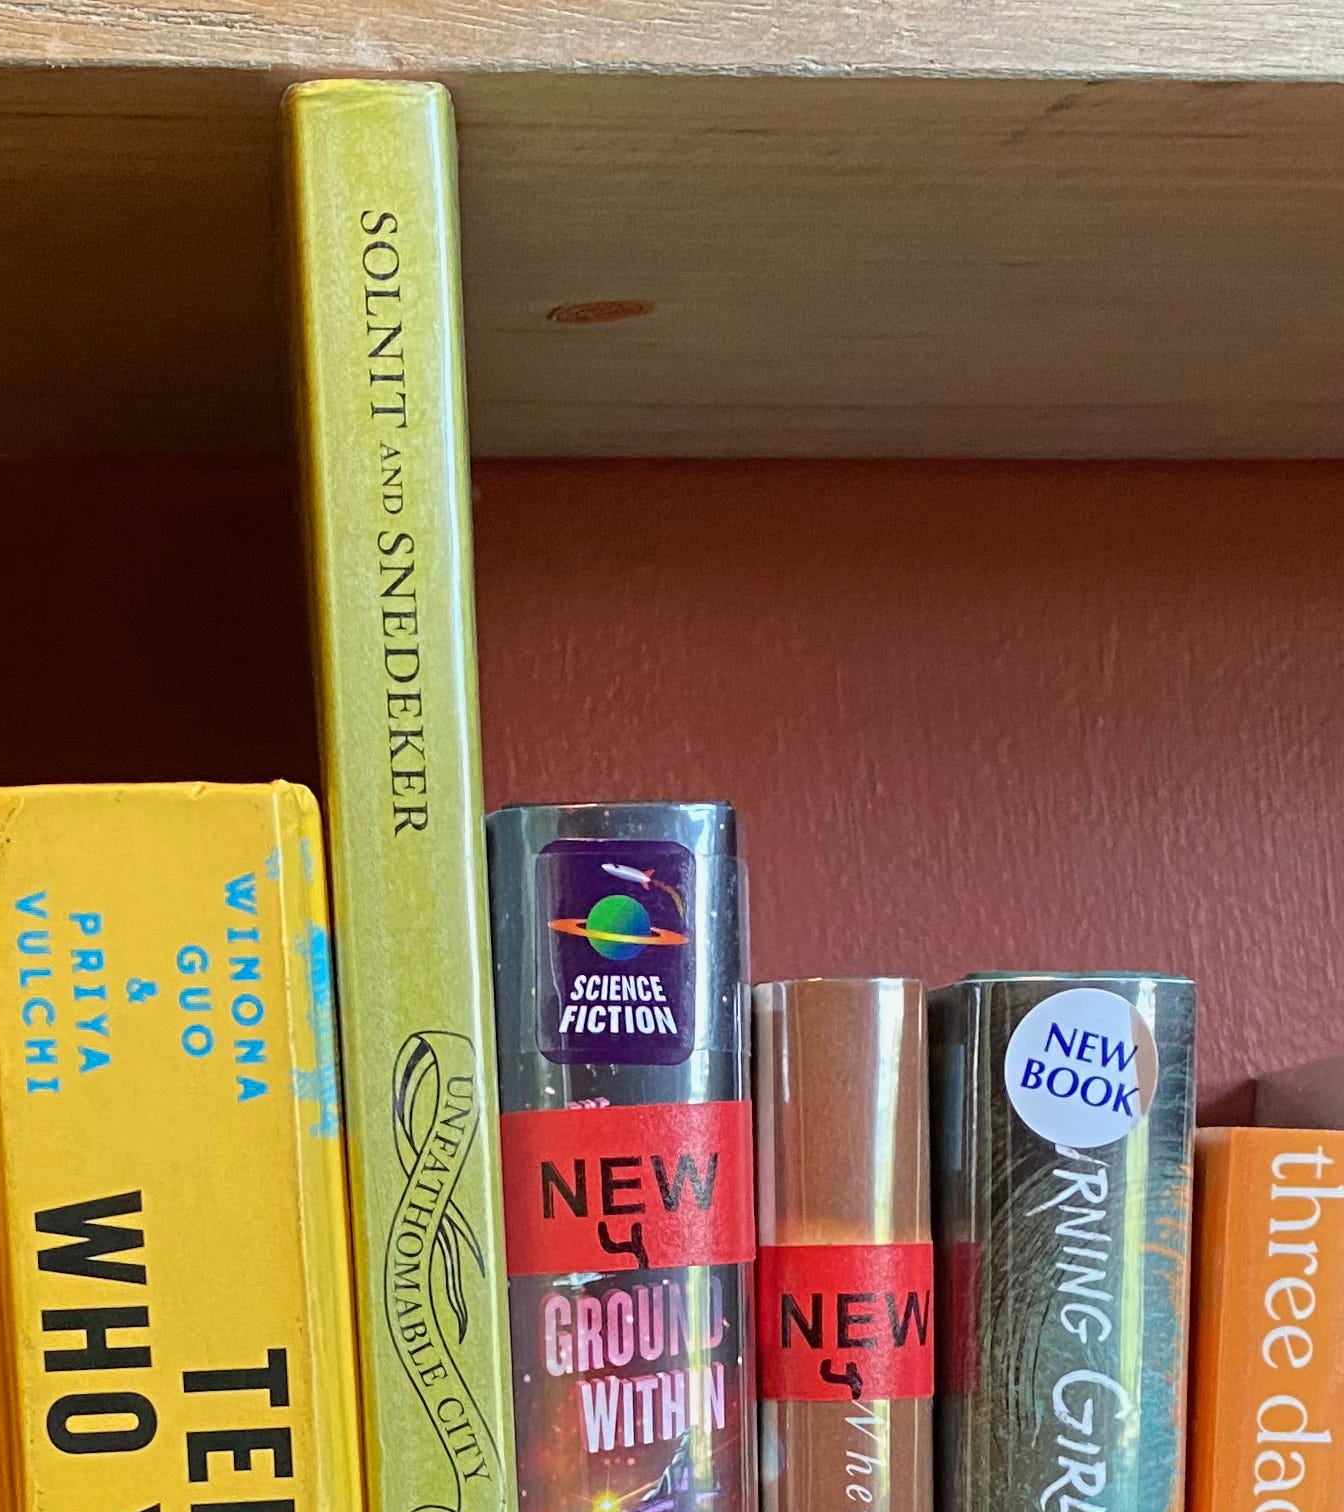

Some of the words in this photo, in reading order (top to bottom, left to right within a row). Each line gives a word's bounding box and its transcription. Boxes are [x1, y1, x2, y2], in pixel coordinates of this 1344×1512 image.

[360, 210, 407, 428] SOLNIT
[380, 442, 404, 515] AND
[377, 531, 429, 837] SNEDEKER
[13, 889, 60, 1096] VULCHI
[68, 911, 111, 1073] PRIYA
[125, 976, 159, 1003] &
[176, 944, 214, 1059] GUO
[223, 871, 270, 1103] WINONA
[559, 1005, 678, 1036] FICTION
[570, 974, 667, 1003] SCIENCE
[1020, 1059, 1140, 1119] BOOK
[1044, 1022, 1140, 1075] NEW
[540, 1152, 718, 1219] NEW
[393, 1075, 474, 1389] UNFATHOMABLE
[437, 1396, 492, 1483] CITY
[1024, 1145, 1113, 1345] RNING
[34, 1189, 157, 1455] WHO
[541, 1276, 724, 1377] GROUND
[781, 1289, 931, 1350] NEW
[578, 1362, 726, 1454] WITHIN
